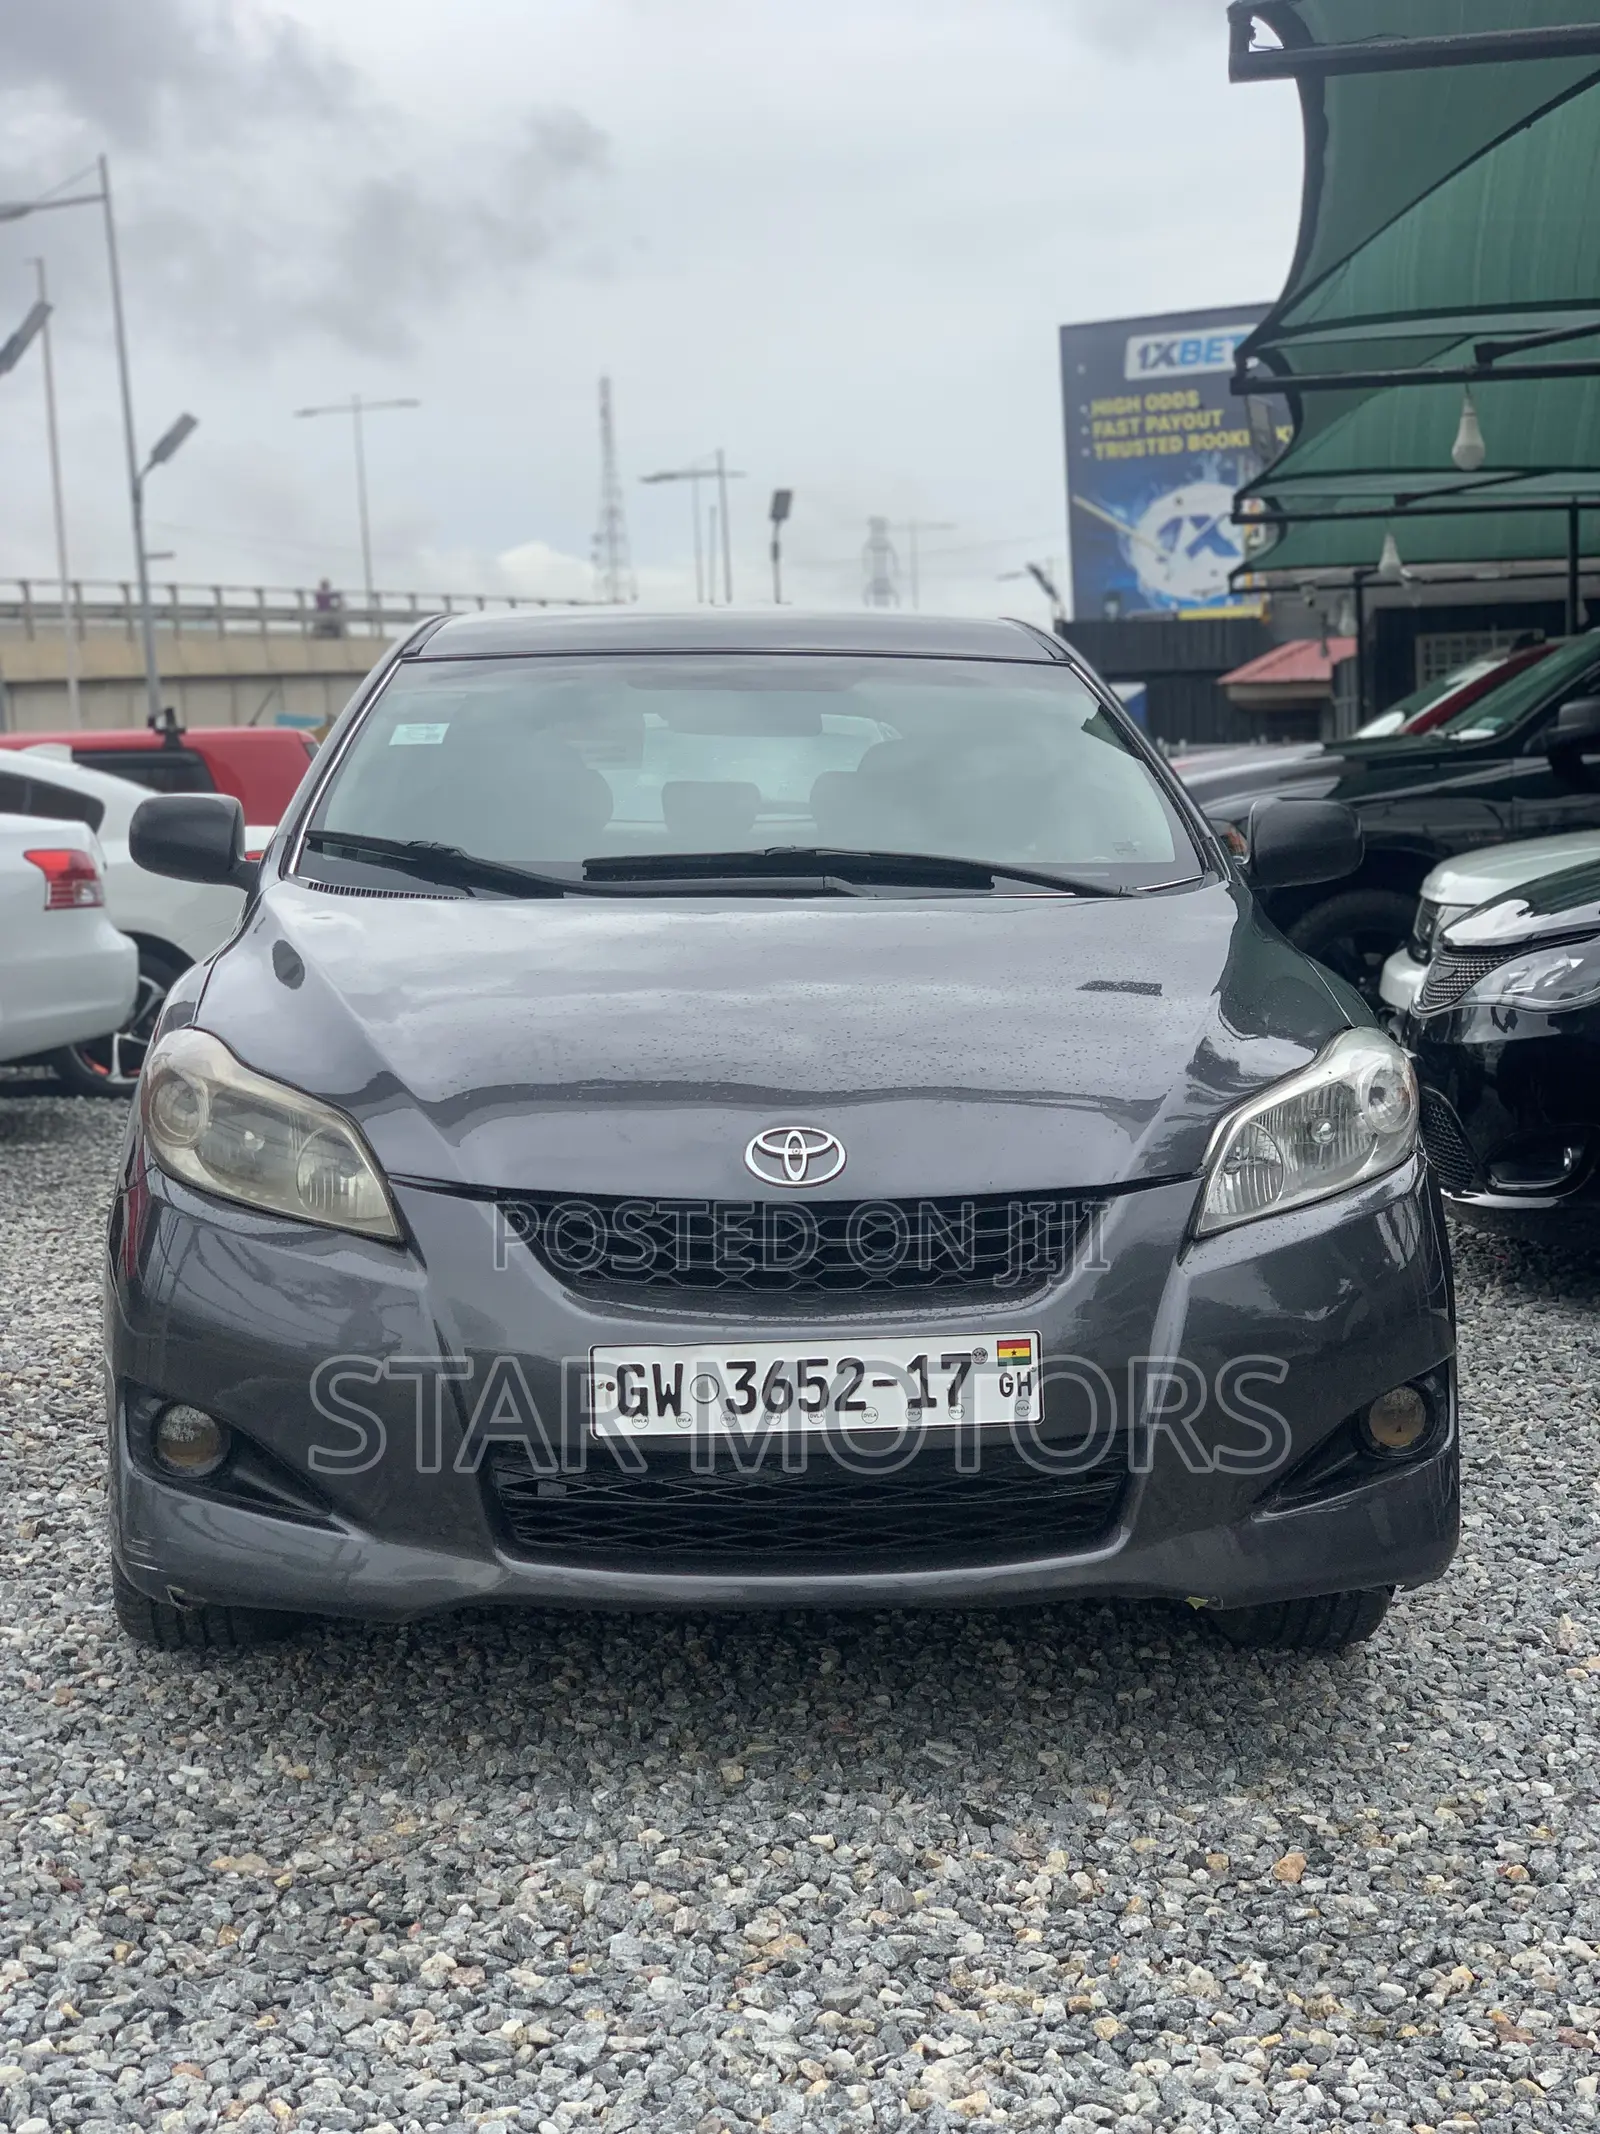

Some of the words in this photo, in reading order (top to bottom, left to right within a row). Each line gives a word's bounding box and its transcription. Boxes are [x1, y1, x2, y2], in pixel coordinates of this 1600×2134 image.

[1145, 390, 1199, 412] ODDS
[1093, 418, 1140, 437] FAST
[1145, 410, 1224, 432] PAYOUT
[1095, 436, 1183, 459] TRUSTED
[616, 1362, 684, 1418] GW
[724, 1351, 972, 1416] 3652-17
[999, 1370, 1033, 1398] GH
